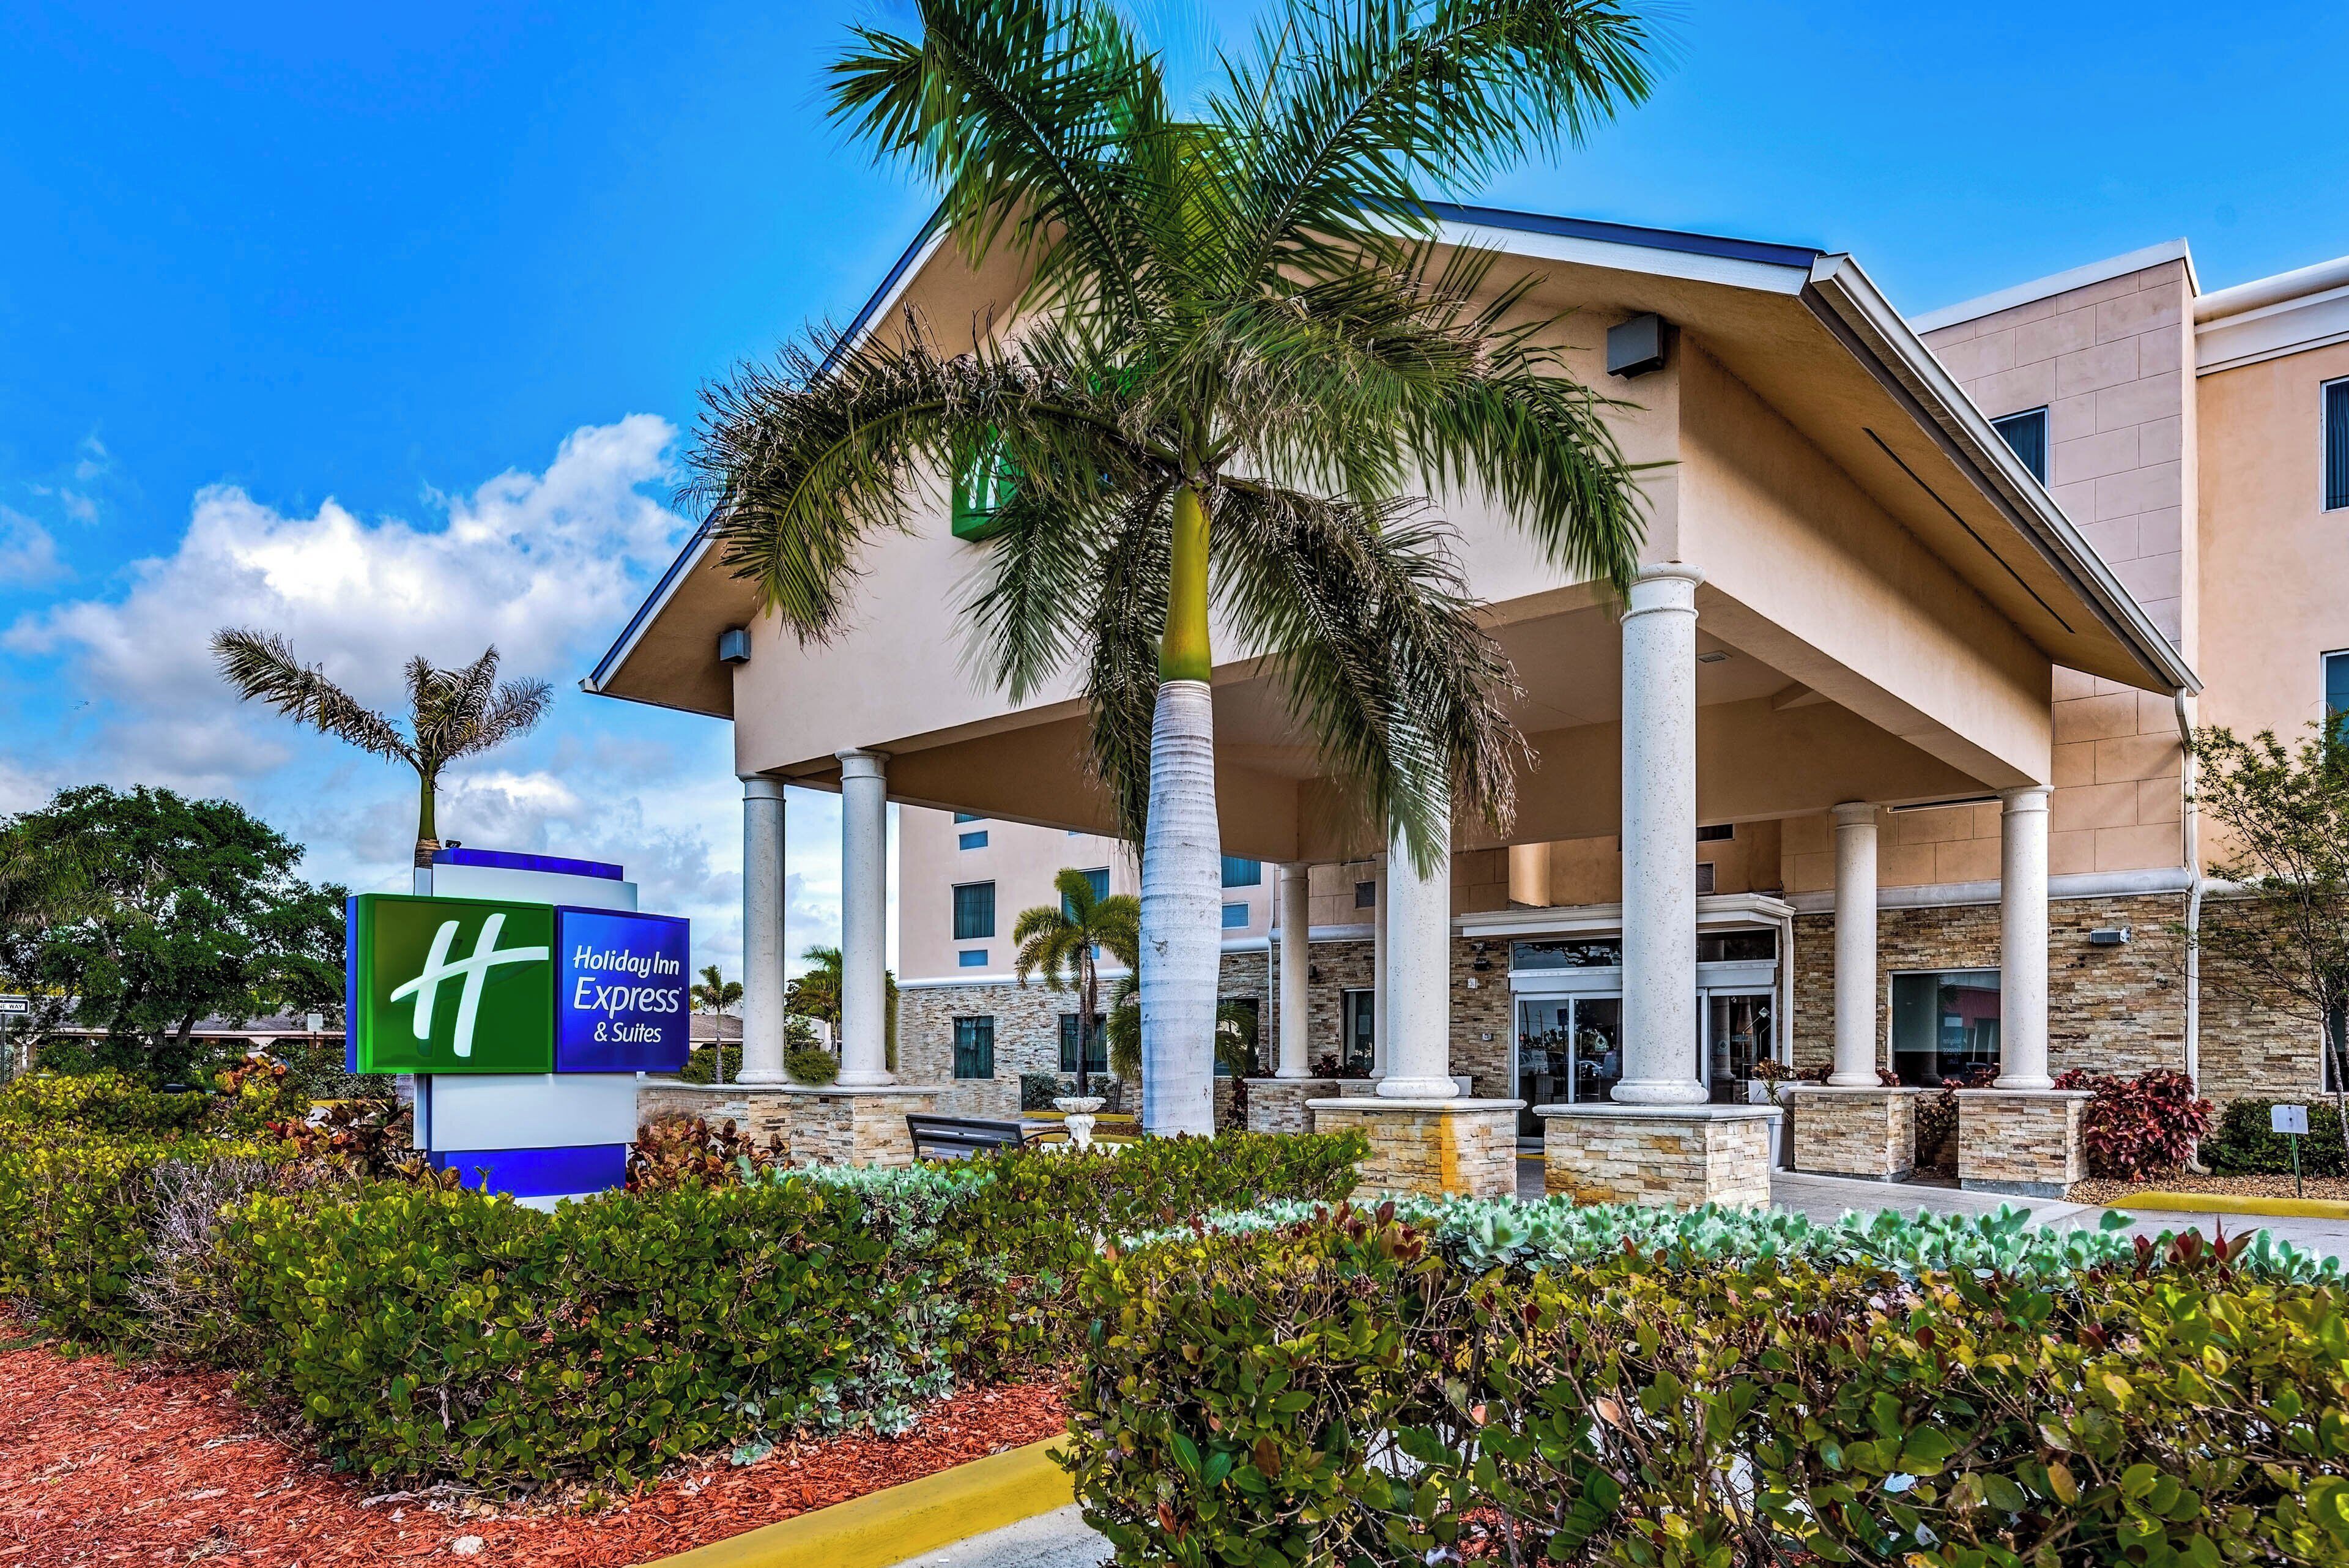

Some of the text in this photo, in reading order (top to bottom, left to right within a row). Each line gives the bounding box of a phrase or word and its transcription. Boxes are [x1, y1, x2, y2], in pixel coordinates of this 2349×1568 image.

[573, 945, 680, 979] Holiday Inn
[573, 976, 680, 1020] Express
[593, 1021, 662, 1043] & Suites
